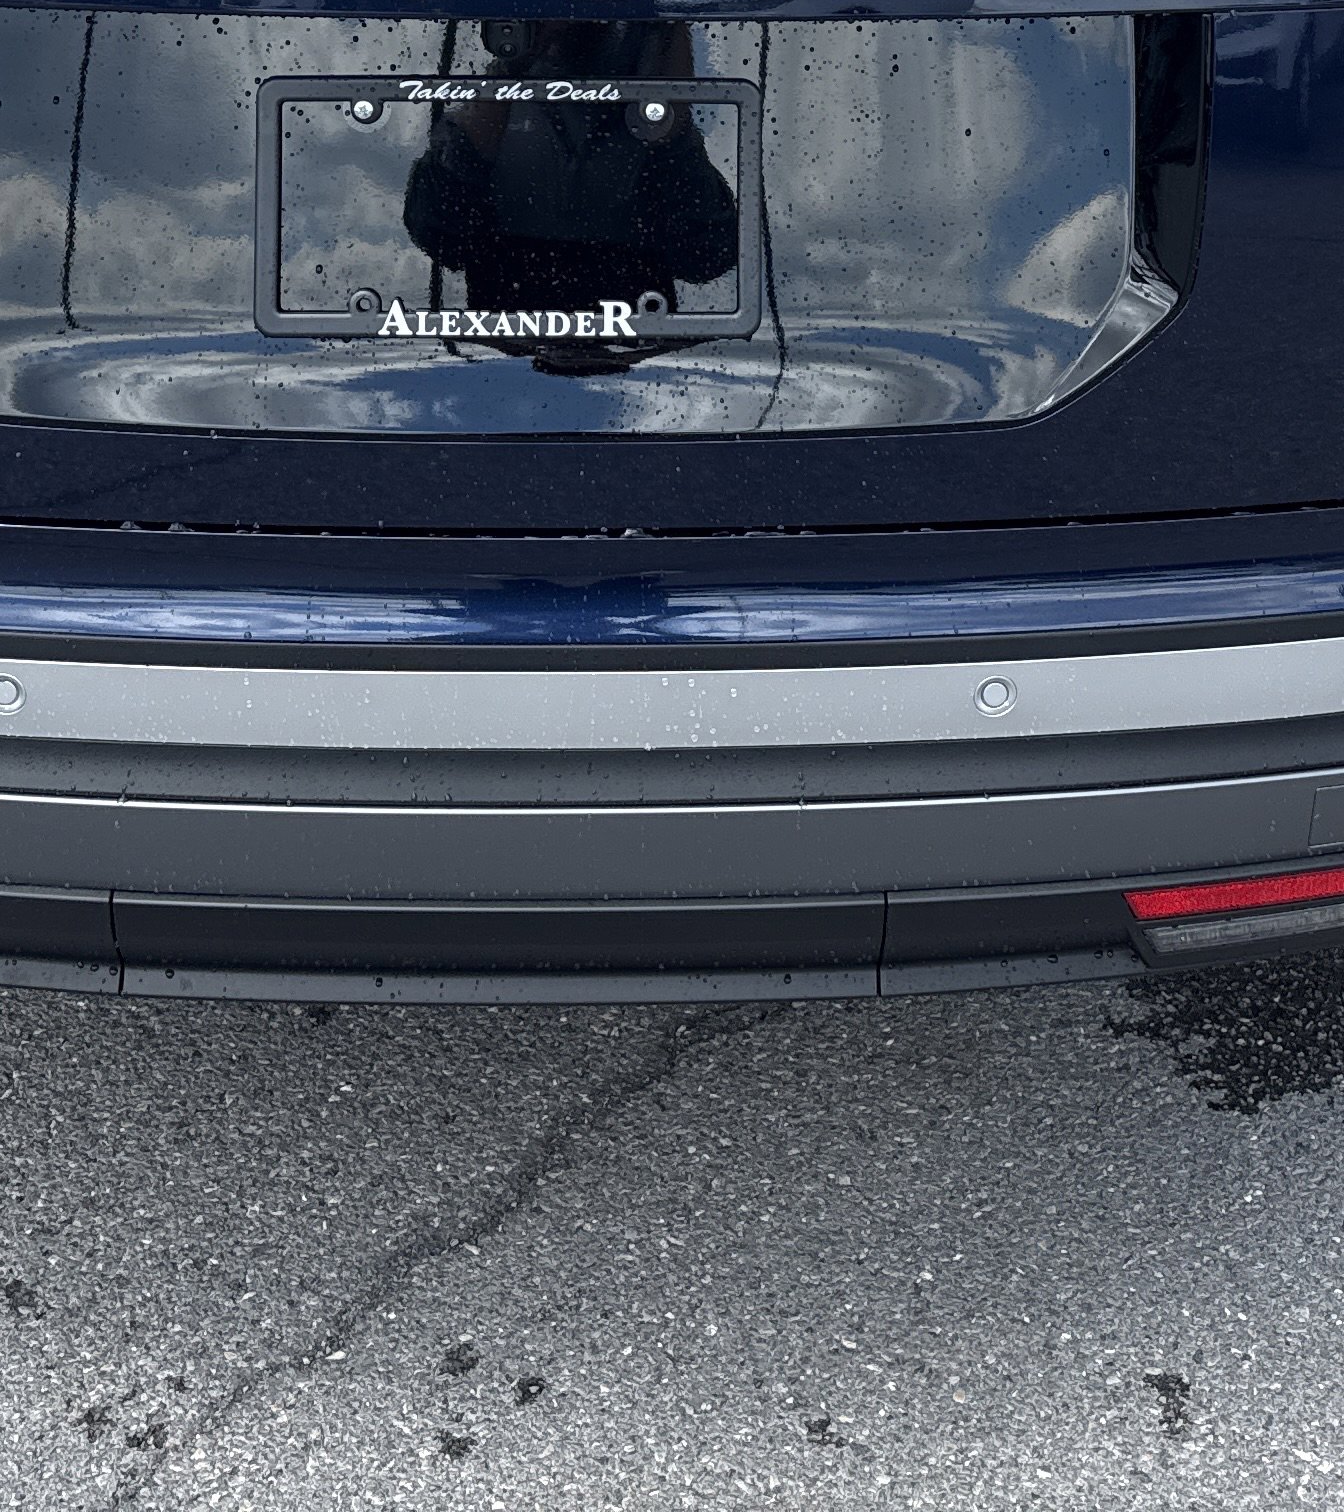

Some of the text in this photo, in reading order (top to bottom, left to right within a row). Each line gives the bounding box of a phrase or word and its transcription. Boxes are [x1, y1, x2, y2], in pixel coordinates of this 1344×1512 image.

[399, 80, 622, 101] Takin' the Deals
